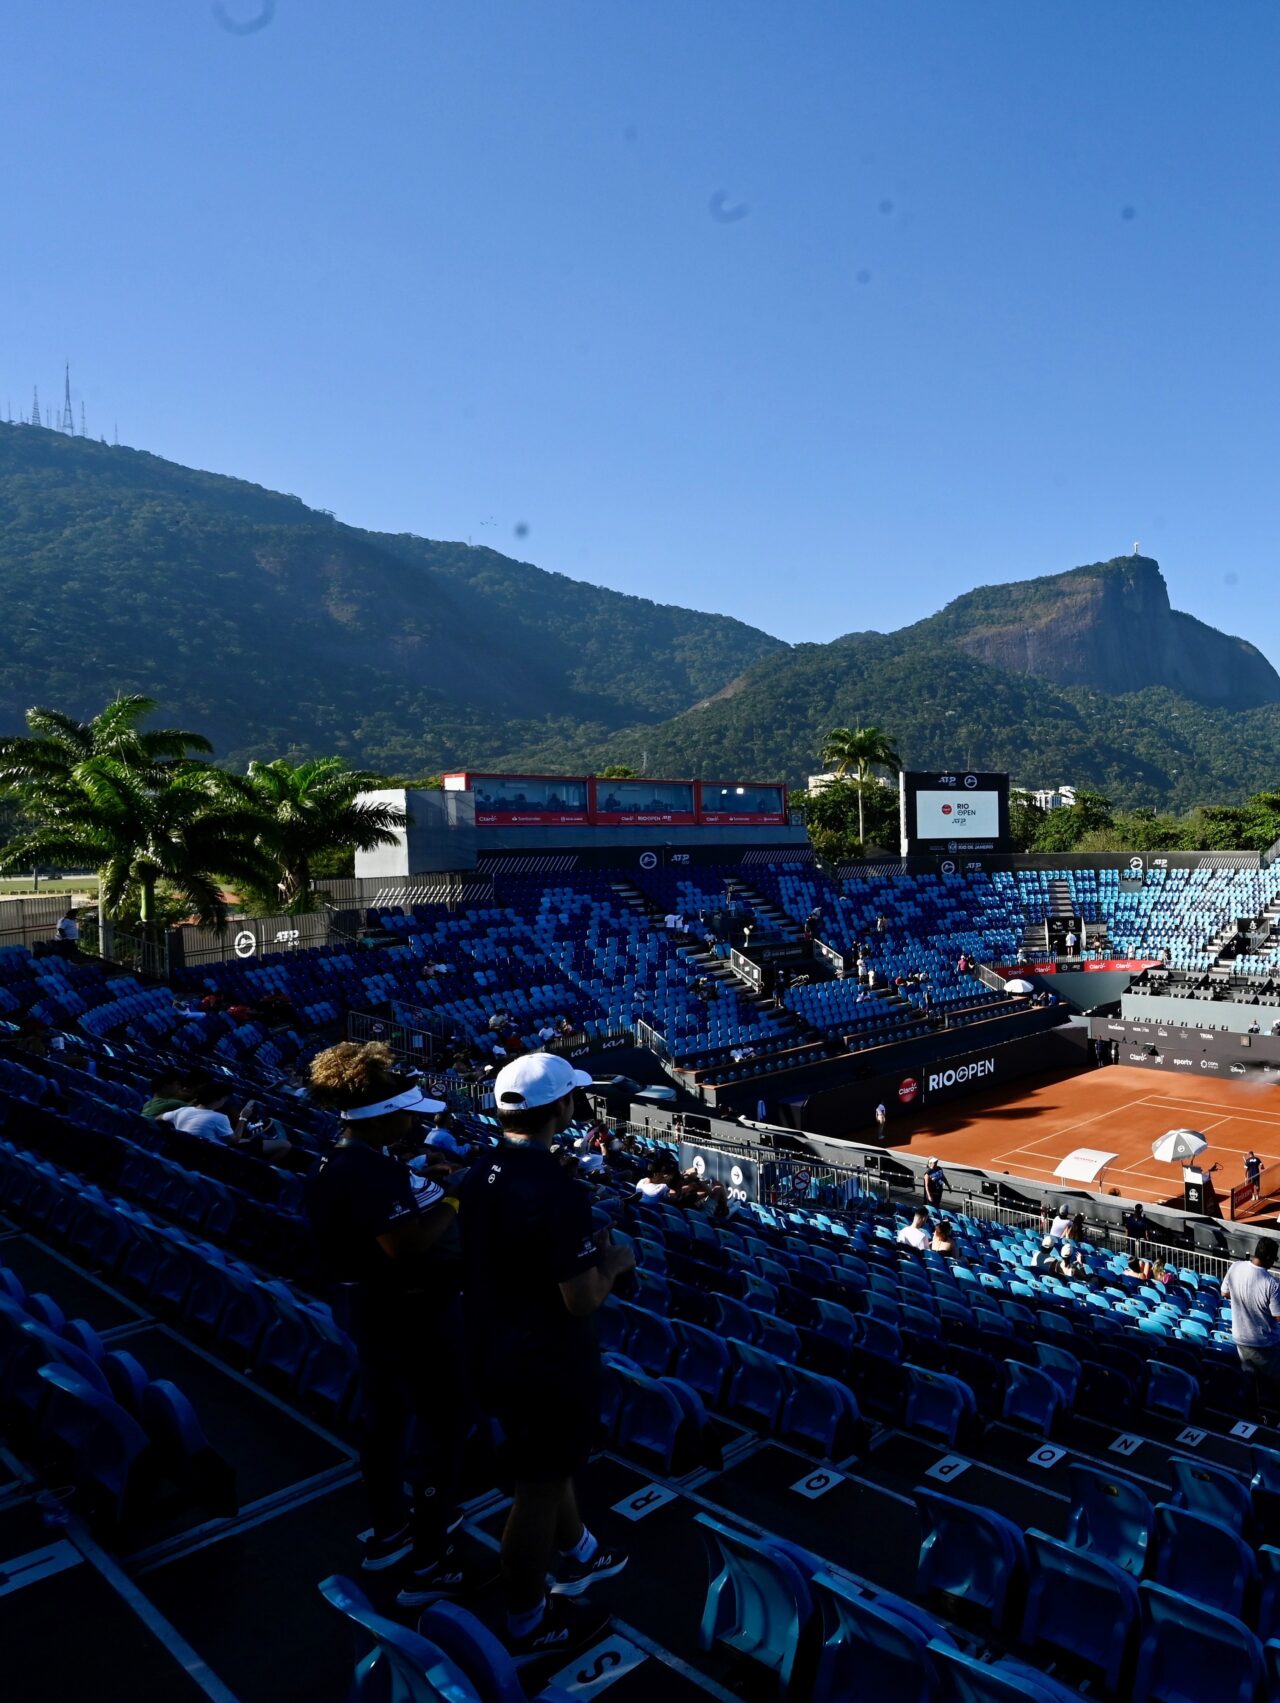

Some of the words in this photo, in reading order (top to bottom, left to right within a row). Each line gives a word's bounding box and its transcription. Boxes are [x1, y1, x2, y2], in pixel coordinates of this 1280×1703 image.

[274, 930, 299, 942] ATP
[1130, 1053, 1147, 1061] Claro
[899, 1084, 916, 1095] Claro
[1240, 1425, 1249, 1433] L
[1184, 1432, 1199, 1441] M
[1119, 1440, 1133, 1450] N
[1038, 1449, 1056, 1461] O
[939, 1463, 960, 1475] P
[805, 1473, 830, 1490] Q
[630, 1490, 655, 1512] R
[577, 1651, 621, 1684] S
